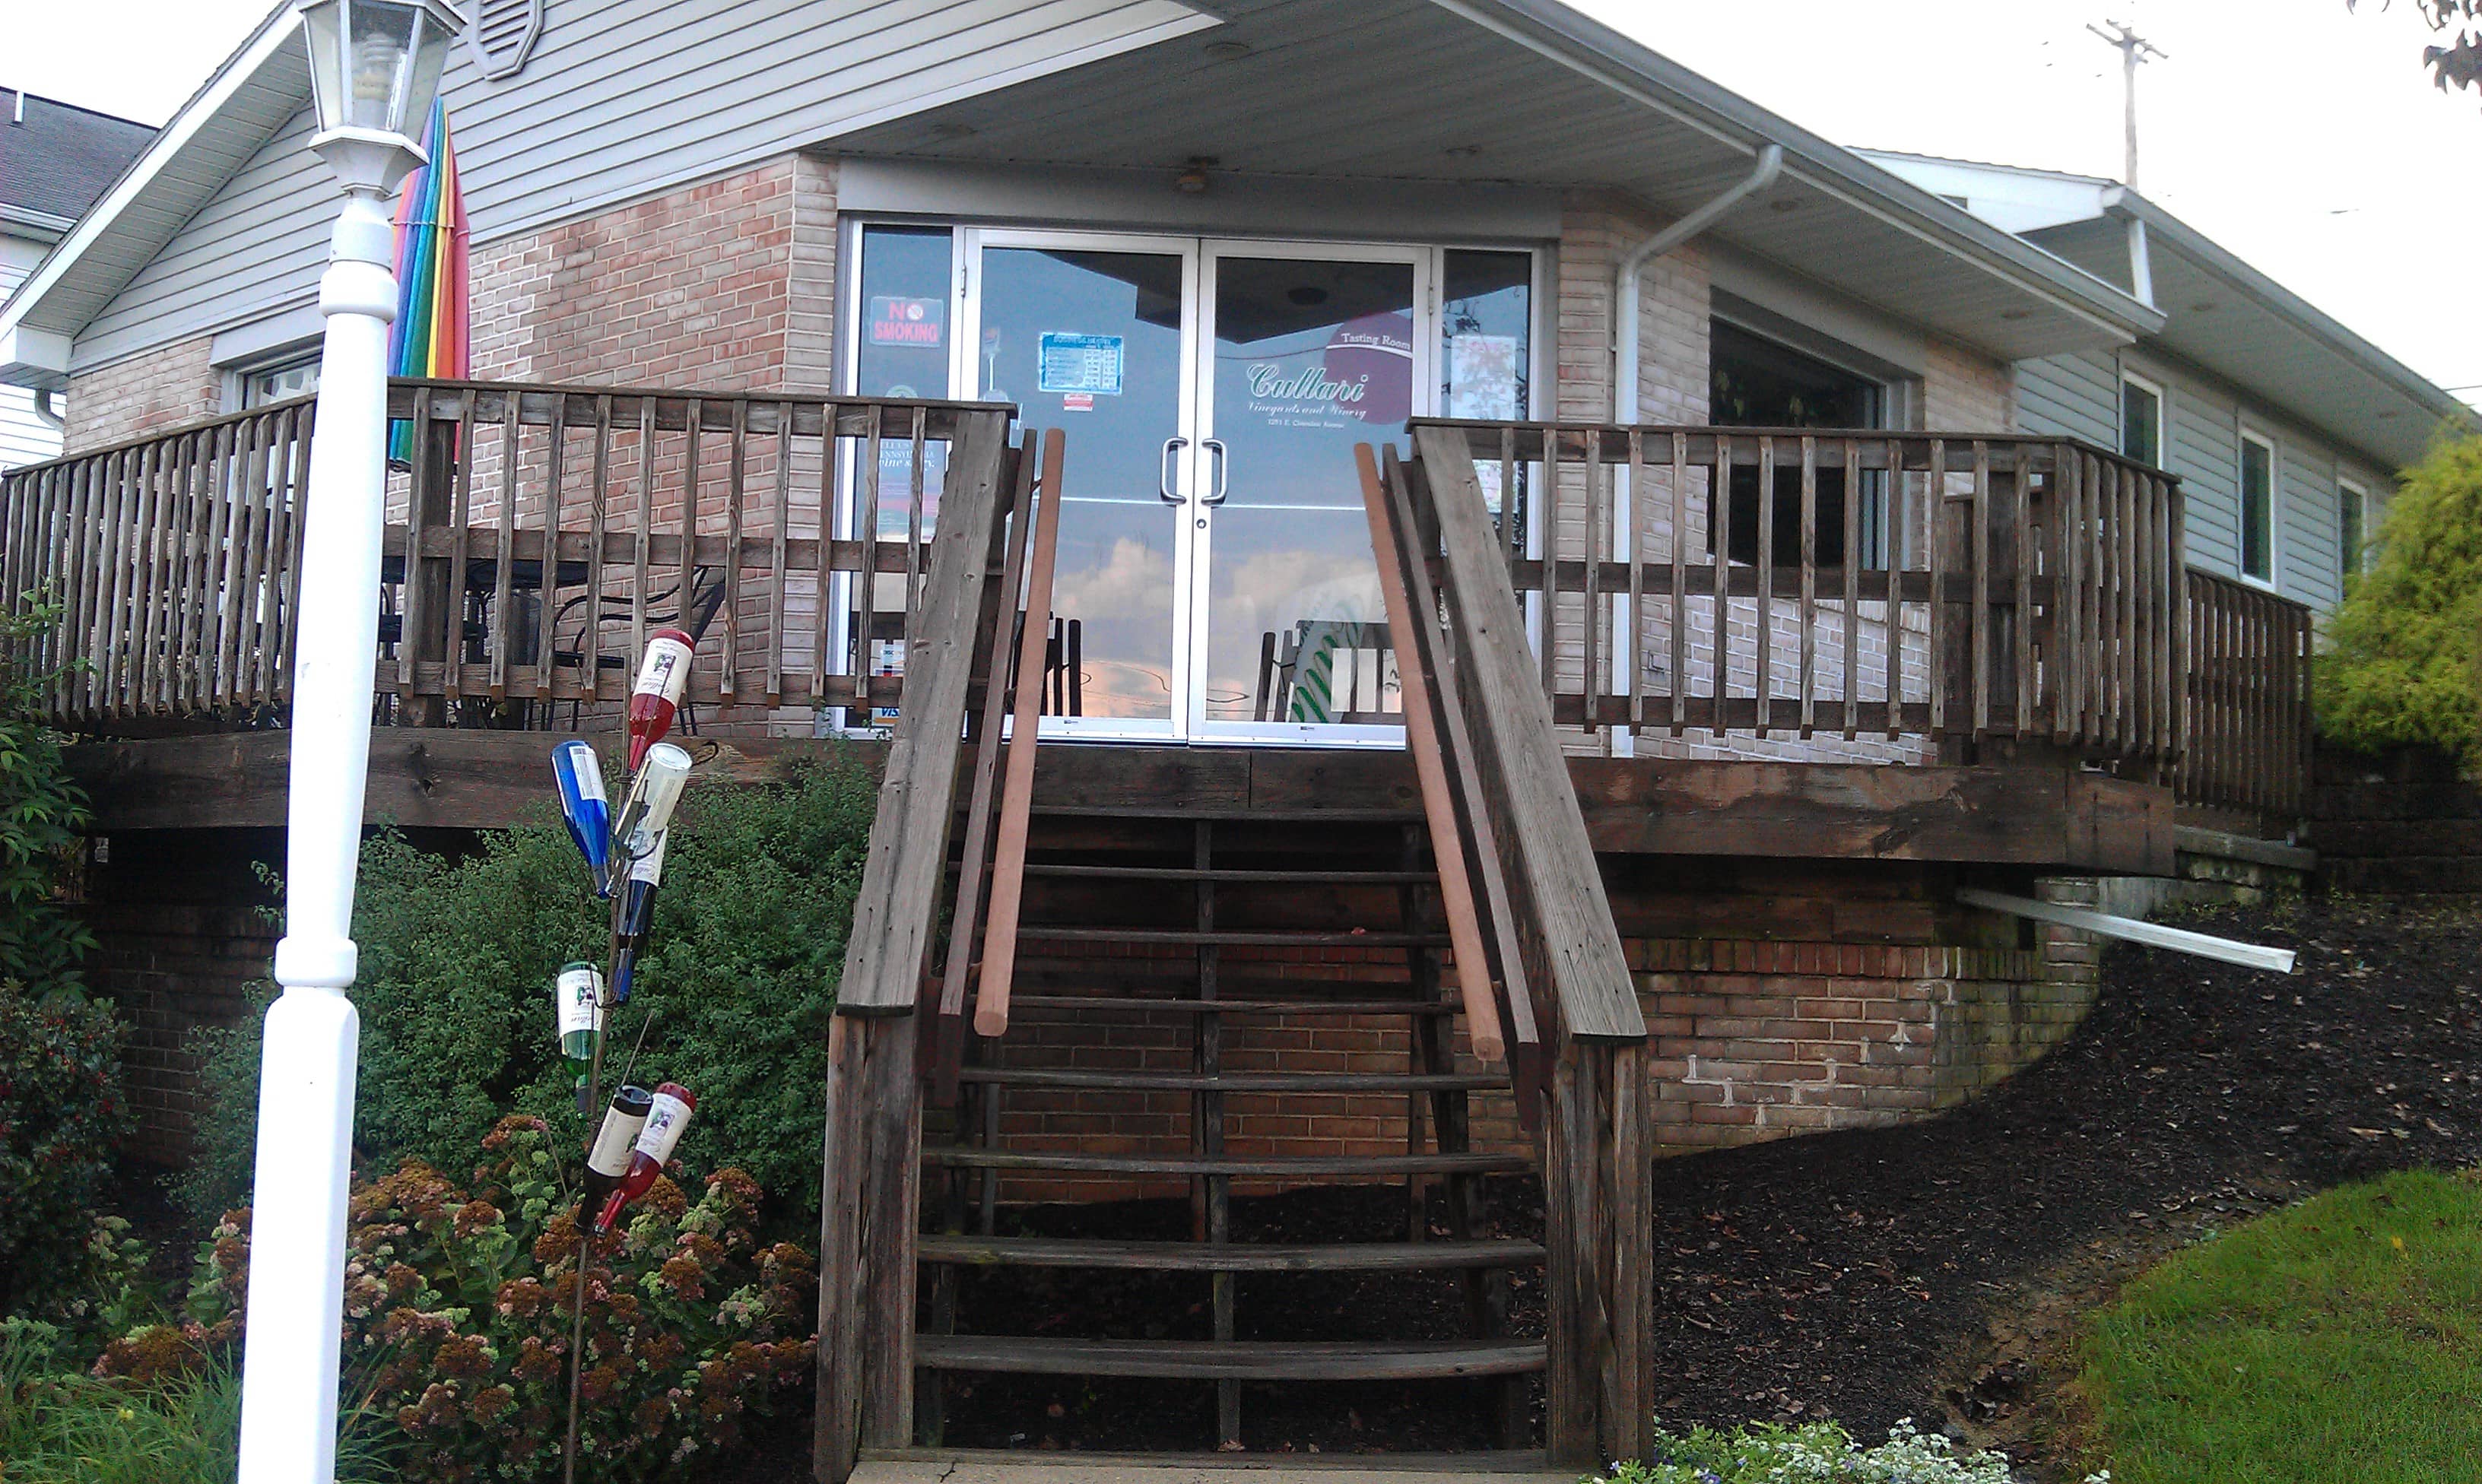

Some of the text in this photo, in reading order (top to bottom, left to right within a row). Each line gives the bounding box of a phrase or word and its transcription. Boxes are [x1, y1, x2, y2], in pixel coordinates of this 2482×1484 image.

[888, 301, 925, 322] NO
[874, 320, 938, 342] SMOKING
[1341, 332, 1412, 350] Tasting Room
[1246, 363, 1370, 403] Cullari
[1248, 401, 1367, 420] Vineyards and Winery
[882, 707, 900, 717] VIS
